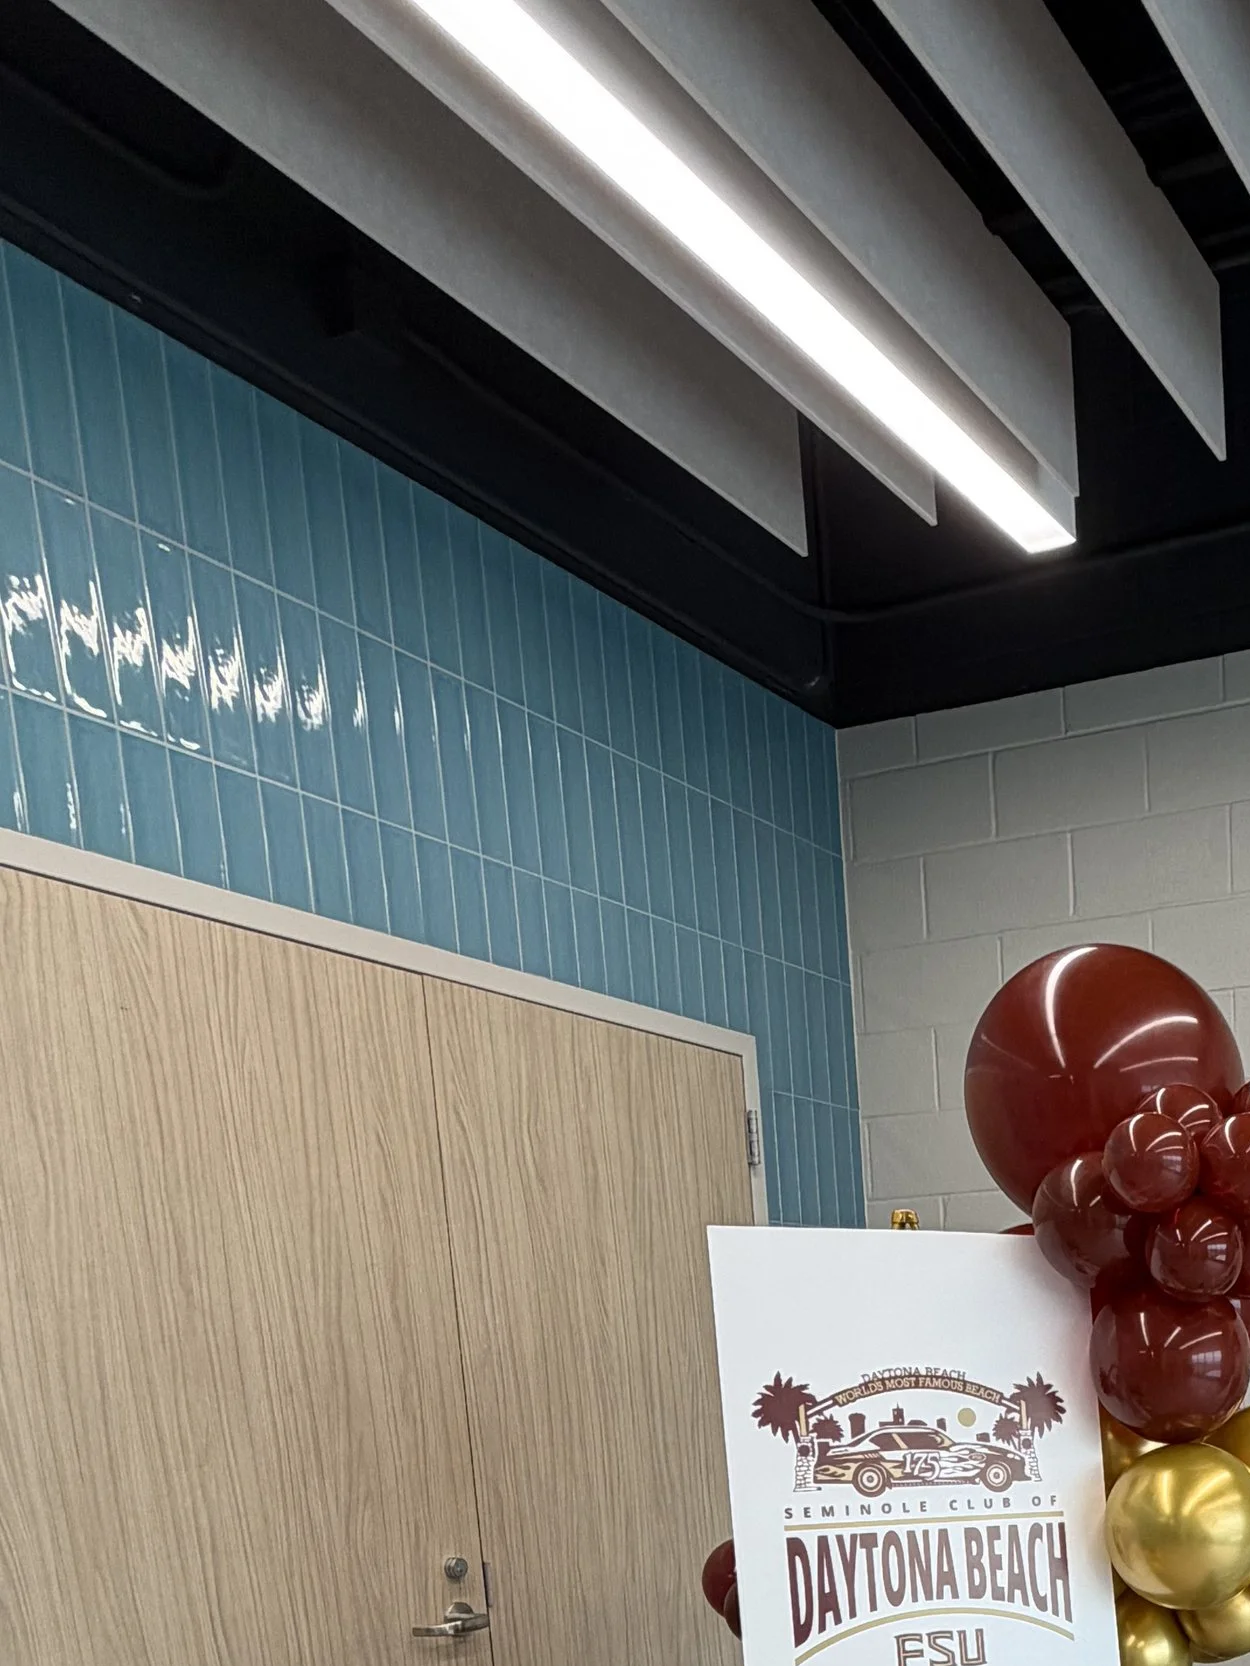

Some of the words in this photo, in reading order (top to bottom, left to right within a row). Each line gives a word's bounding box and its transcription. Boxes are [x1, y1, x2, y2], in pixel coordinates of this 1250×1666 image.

[861, 1366, 921, 1382] DAYTONA
[925, 1366, 967, 1381] BEACH
[885, 1377, 916, 1390] MOST
[919, 1377, 964, 1392] FAMOUS
[965, 1384, 1001, 1404] BEACH
[902, 1450, 942, 1481] 175
[784, 1500, 928, 1520] SEMINOLE
[949, 1497, 1012, 1511] CLUB
[1031, 1495, 1058, 1507] OF
[785, 1528, 960, 1649] DAYTONA
[963, 1522, 1074, 1624] BEACH
